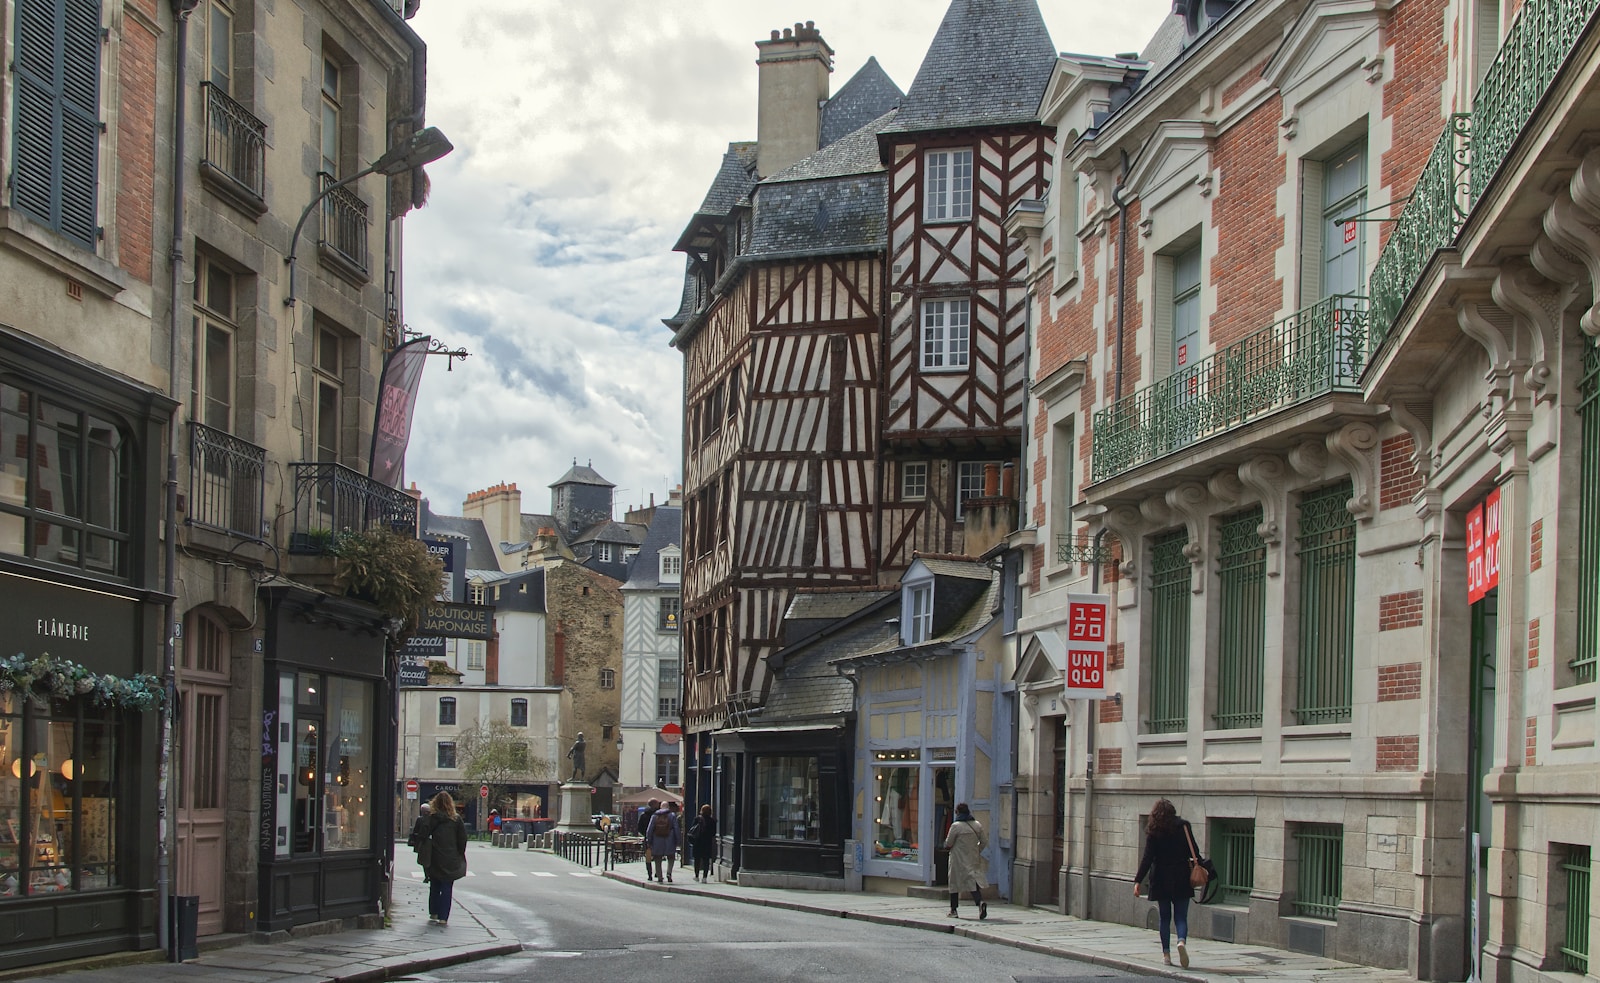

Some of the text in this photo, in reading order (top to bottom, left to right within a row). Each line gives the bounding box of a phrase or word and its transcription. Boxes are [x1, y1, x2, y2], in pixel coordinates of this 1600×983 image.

[428, 608, 485, 621] BOUTIQUE
[1075, 608, 1101, 621] ユニ
[38, 618, 89, 641] FLÂNERIE
[425, 620, 487, 634] JAPONAISE
[1073, 624, 1101, 637] クロ
[406, 636, 443, 647] acadi
[1072, 654, 1098, 668] UNI
[1071, 669, 1100, 685] QLO
